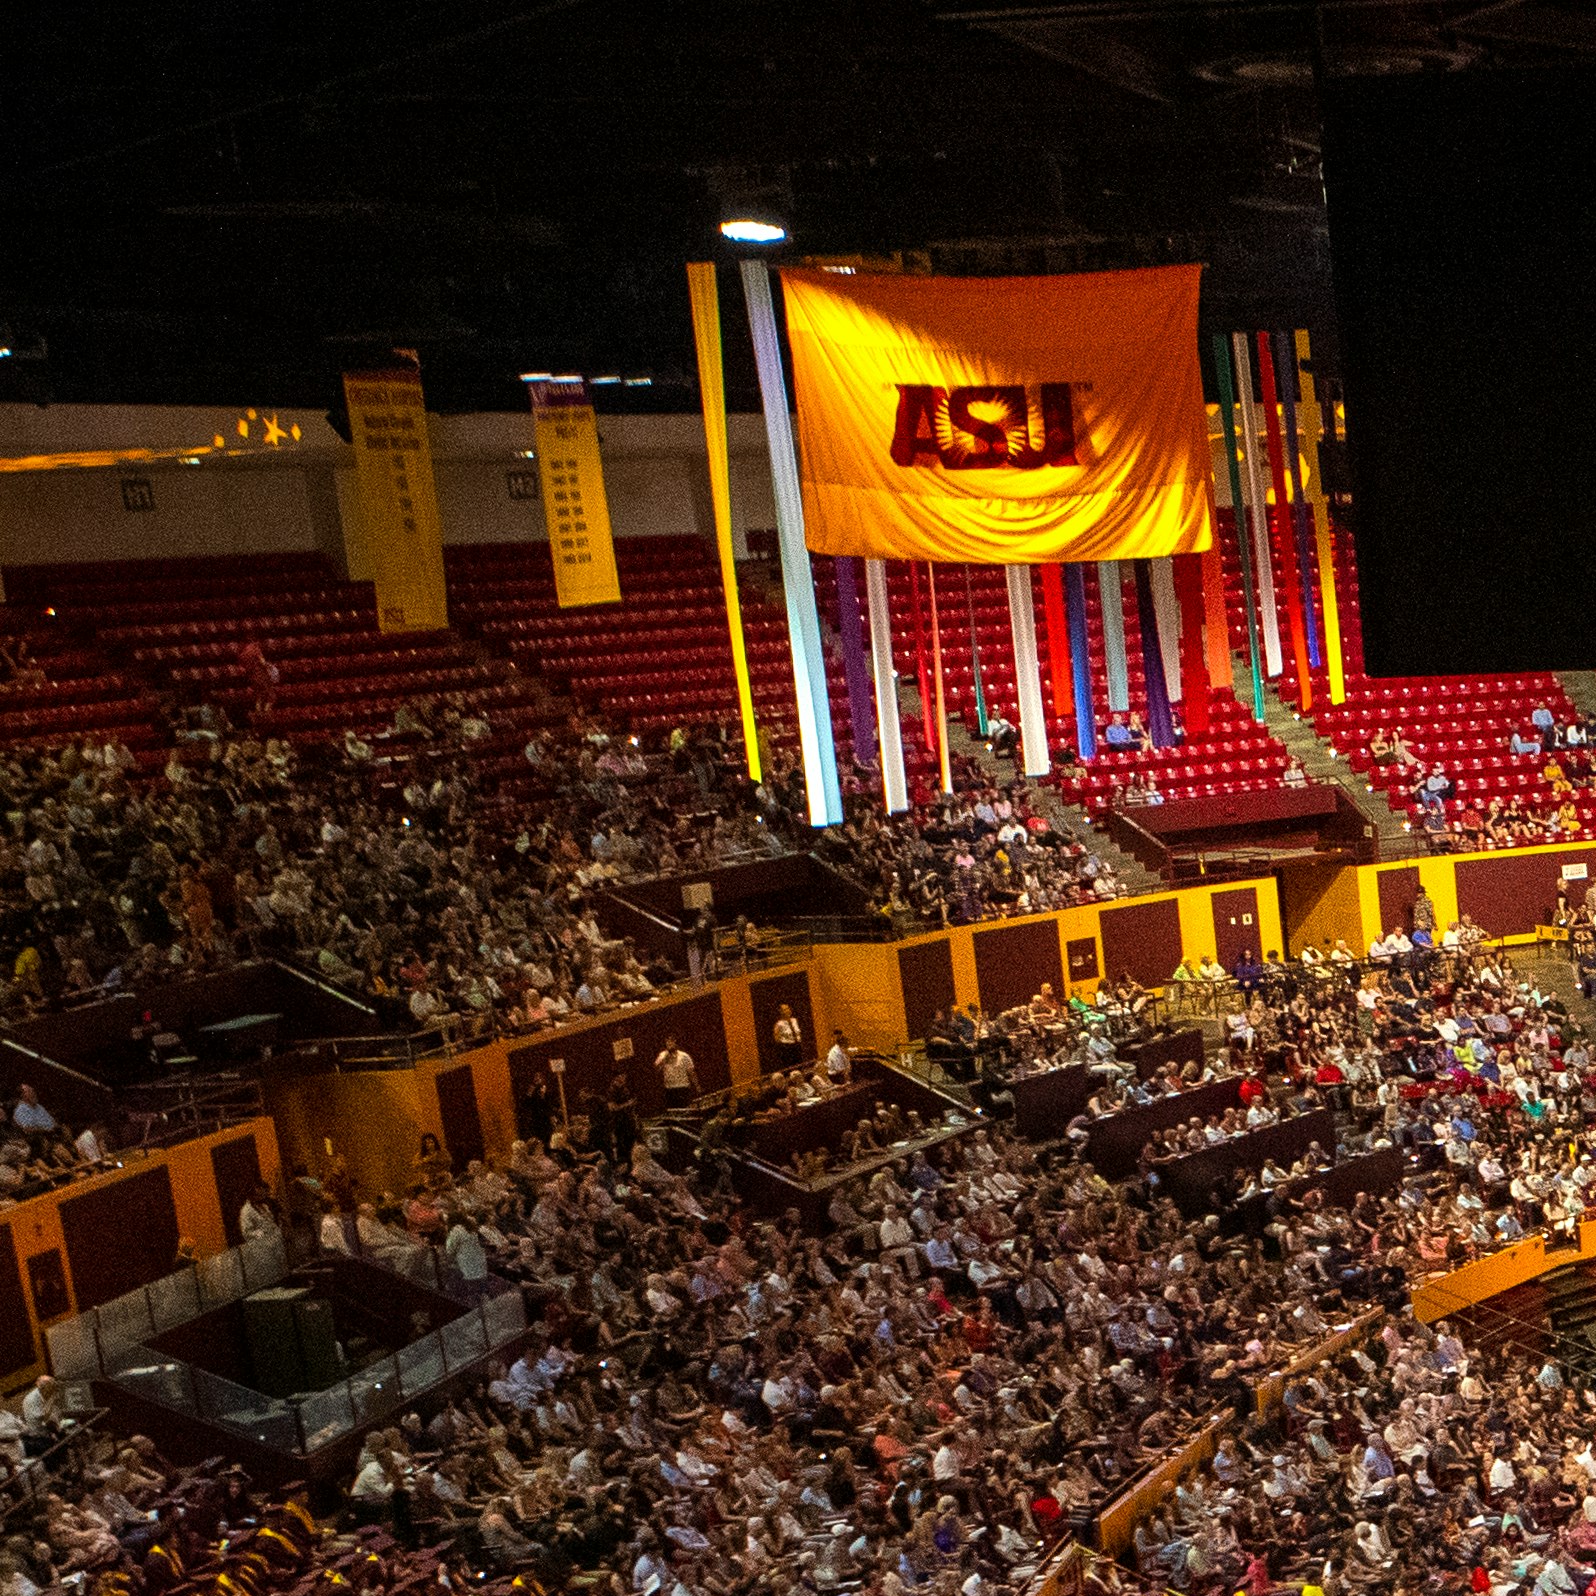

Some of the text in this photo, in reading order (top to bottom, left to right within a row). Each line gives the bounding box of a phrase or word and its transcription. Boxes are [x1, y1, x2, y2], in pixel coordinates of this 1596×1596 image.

[890, 382, 1078, 469] ASU
[647, 1133, 662, 1150] G
[65, 1387, 84, 1410] E
